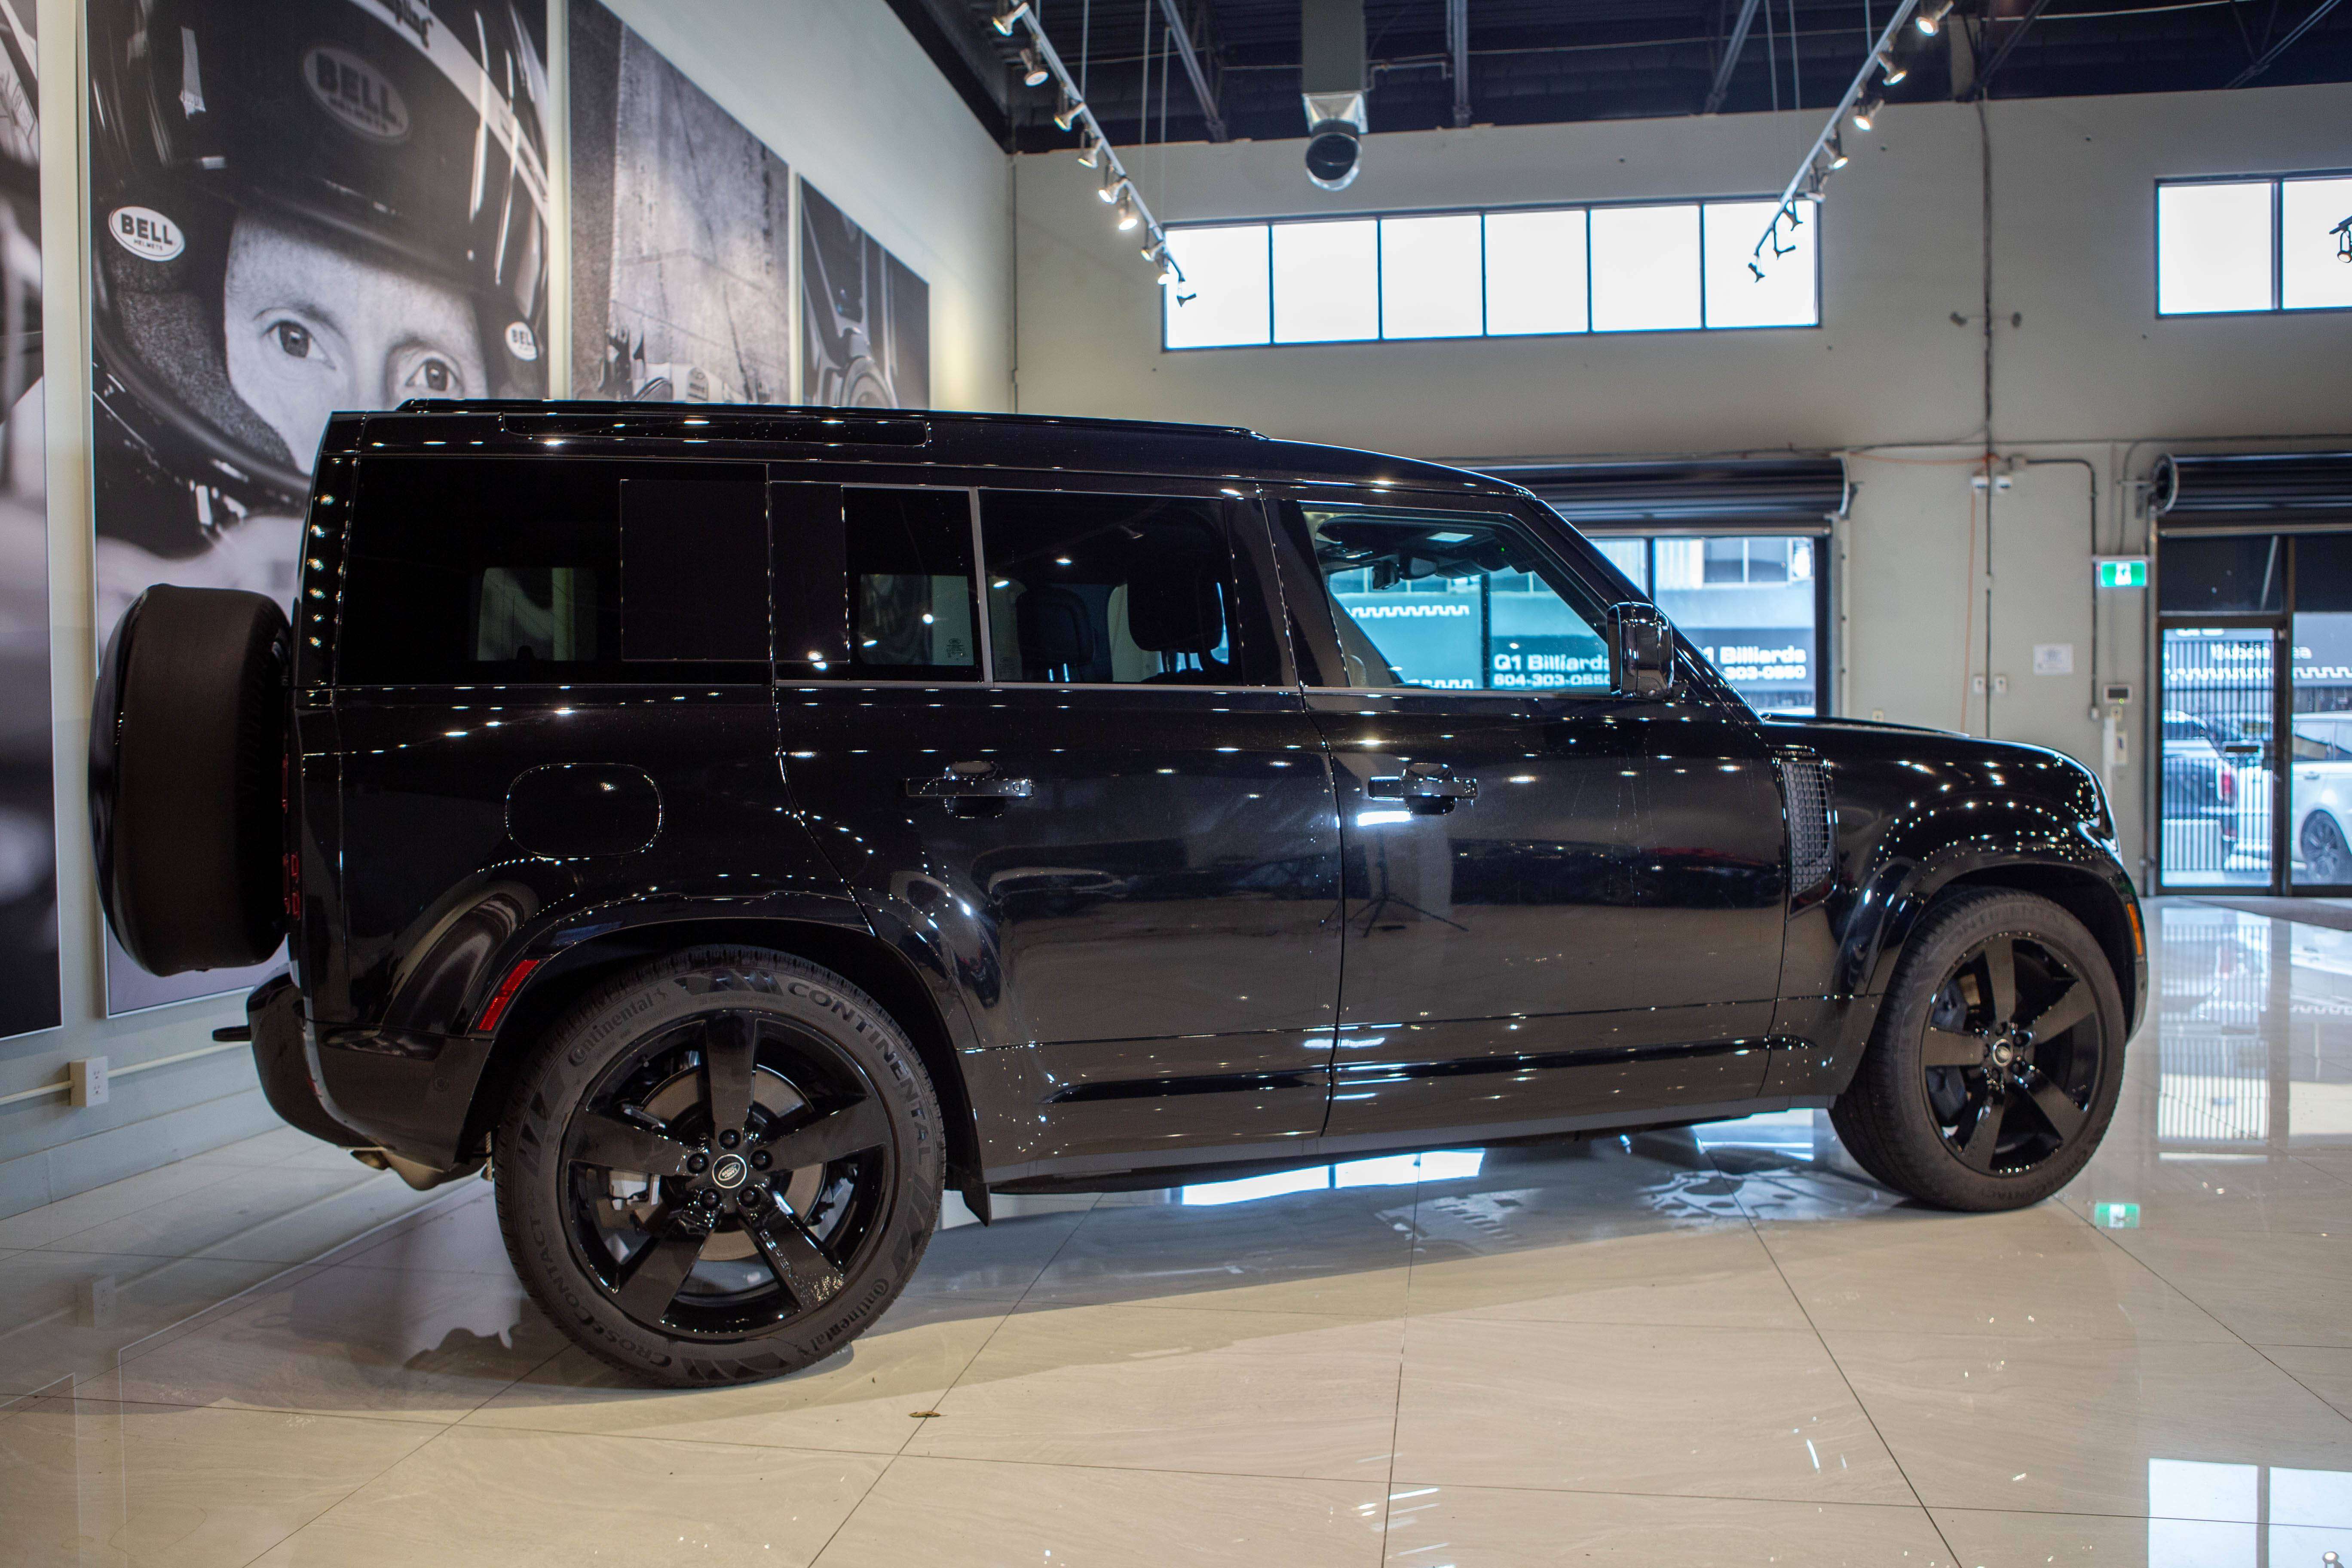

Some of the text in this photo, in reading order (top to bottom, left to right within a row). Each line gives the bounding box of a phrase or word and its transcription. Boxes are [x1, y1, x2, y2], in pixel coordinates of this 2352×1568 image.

[316, 54, 398, 126] BELL
[121, 213, 173, 245] BELL
[511, 328, 533, 346] BEL
[1494, 654, 1522, 670] Q1
[1720, 645, 1806, 665] Billiards
[568, 992, 654, 1067] Continental
[788, 982, 931, 1163] CONTINENTAL
[809, 1278, 889, 1352] Continental
